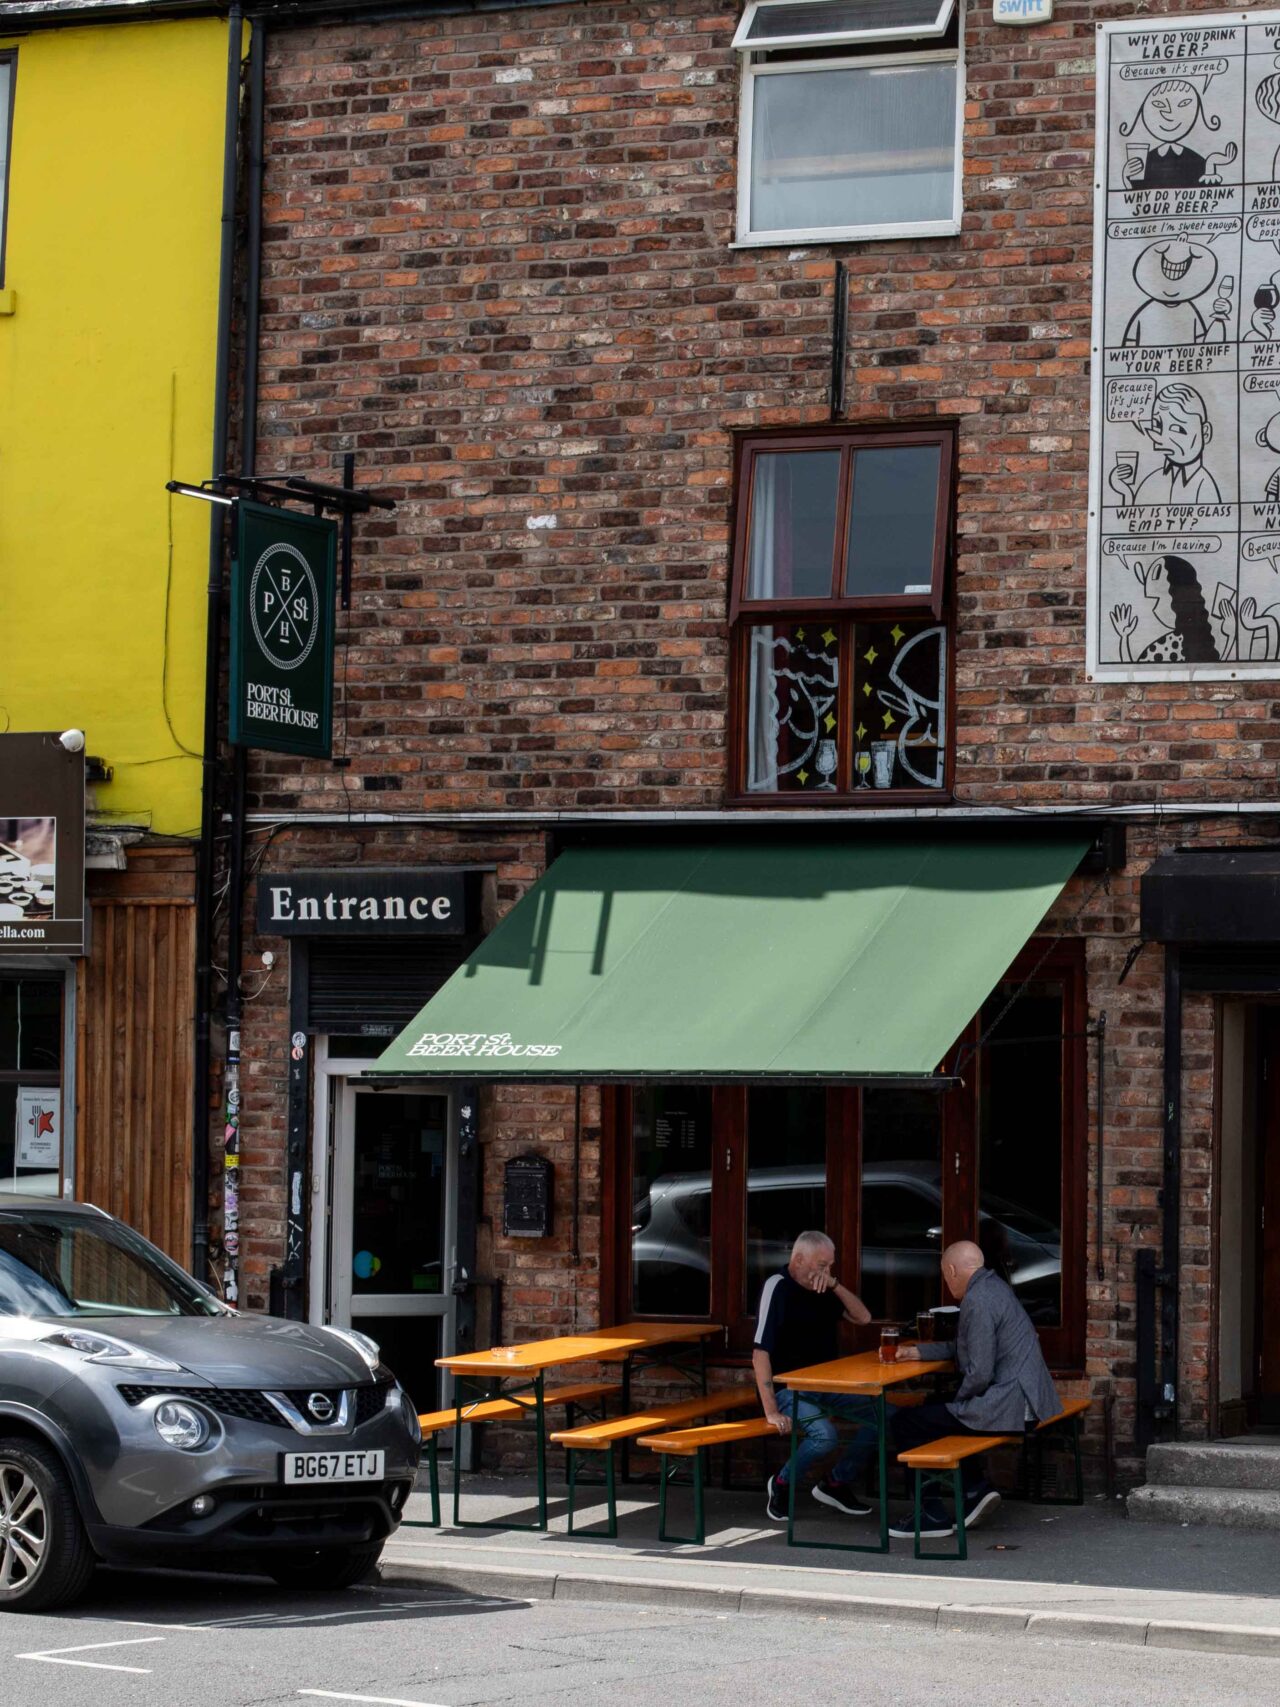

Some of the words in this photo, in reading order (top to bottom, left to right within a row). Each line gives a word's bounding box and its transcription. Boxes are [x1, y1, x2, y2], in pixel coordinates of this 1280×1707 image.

[1128, 34, 1158, 46] WHY
[1163, 33, 1176, 44] DO
[1181, 32, 1200, 42] YOU
[1203, 29, 1236, 41] DRINK
[1142, 42, 1209, 59] LAGER?
[1124, 63, 1166, 78] Because
[1171, 63, 1188, 74] it's
[1191, 60, 1222, 75] great
[1124, 191, 1151, 204] WHY
[1155, 190, 1169, 201] DO
[1175, 190, 1197, 200] YOU
[1200, 188, 1234, 200] DRINK
[1132, 202, 1170, 216] SOUR
[1175, 200, 1219, 214] BEER?
[1113, 225, 1157, 236] Because
[1160, 222, 1175, 232] I'm
[1178, 220, 1205, 230] sweet
[1207, 220, 1238, 231] enough
[1110, 350, 1138, 361] WHY
[1141, 348, 1173, 360] DON'T
[1176, 347, 1195, 359] YOU
[1198, 345, 1230, 357] SNIFF
[1125, 361, 1160, 373] YOUR
[1169, 358, 1213, 373] BEER?
[1251, 355, 1275, 368] THE
[1110, 381, 1153, 394] Because
[1110, 396, 1124, 406] it's
[1127, 393, 1152, 407] just
[1110, 407, 1144, 420] beer?
[1116, 508, 1145, 520] WHY
[1150, 507, 1161, 518] IS
[1166, 506, 1194, 518] YOUR
[1197, 505, 1232, 517] GLASS
[1128, 517, 1199, 532] EMPTY?
[1108, 540, 1147, 553] Because
[1151, 540, 1167, 551] I'm
[1172, 539, 1211, 553] leaving
[281, 575, 291, 591] B
[263, 591, 275, 613] P
[280, 621, 290, 637] H
[246, 682, 280, 704] PORT
[279, 687, 294, 707] St.
[246, 700, 279, 722] BEER
[280, 707, 319, 729] HOUSE
[269, 887, 451, 921] Entrance
[415, 1033, 487, 1046] PORT
[484, 1032, 513, 1046] St.
[405, 1044, 477, 1057] BEER
[475, 1045, 563, 1057] HOUSE
[294, 1455, 340, 1478] BG67
[345, 1454, 377, 1476] ETJ
